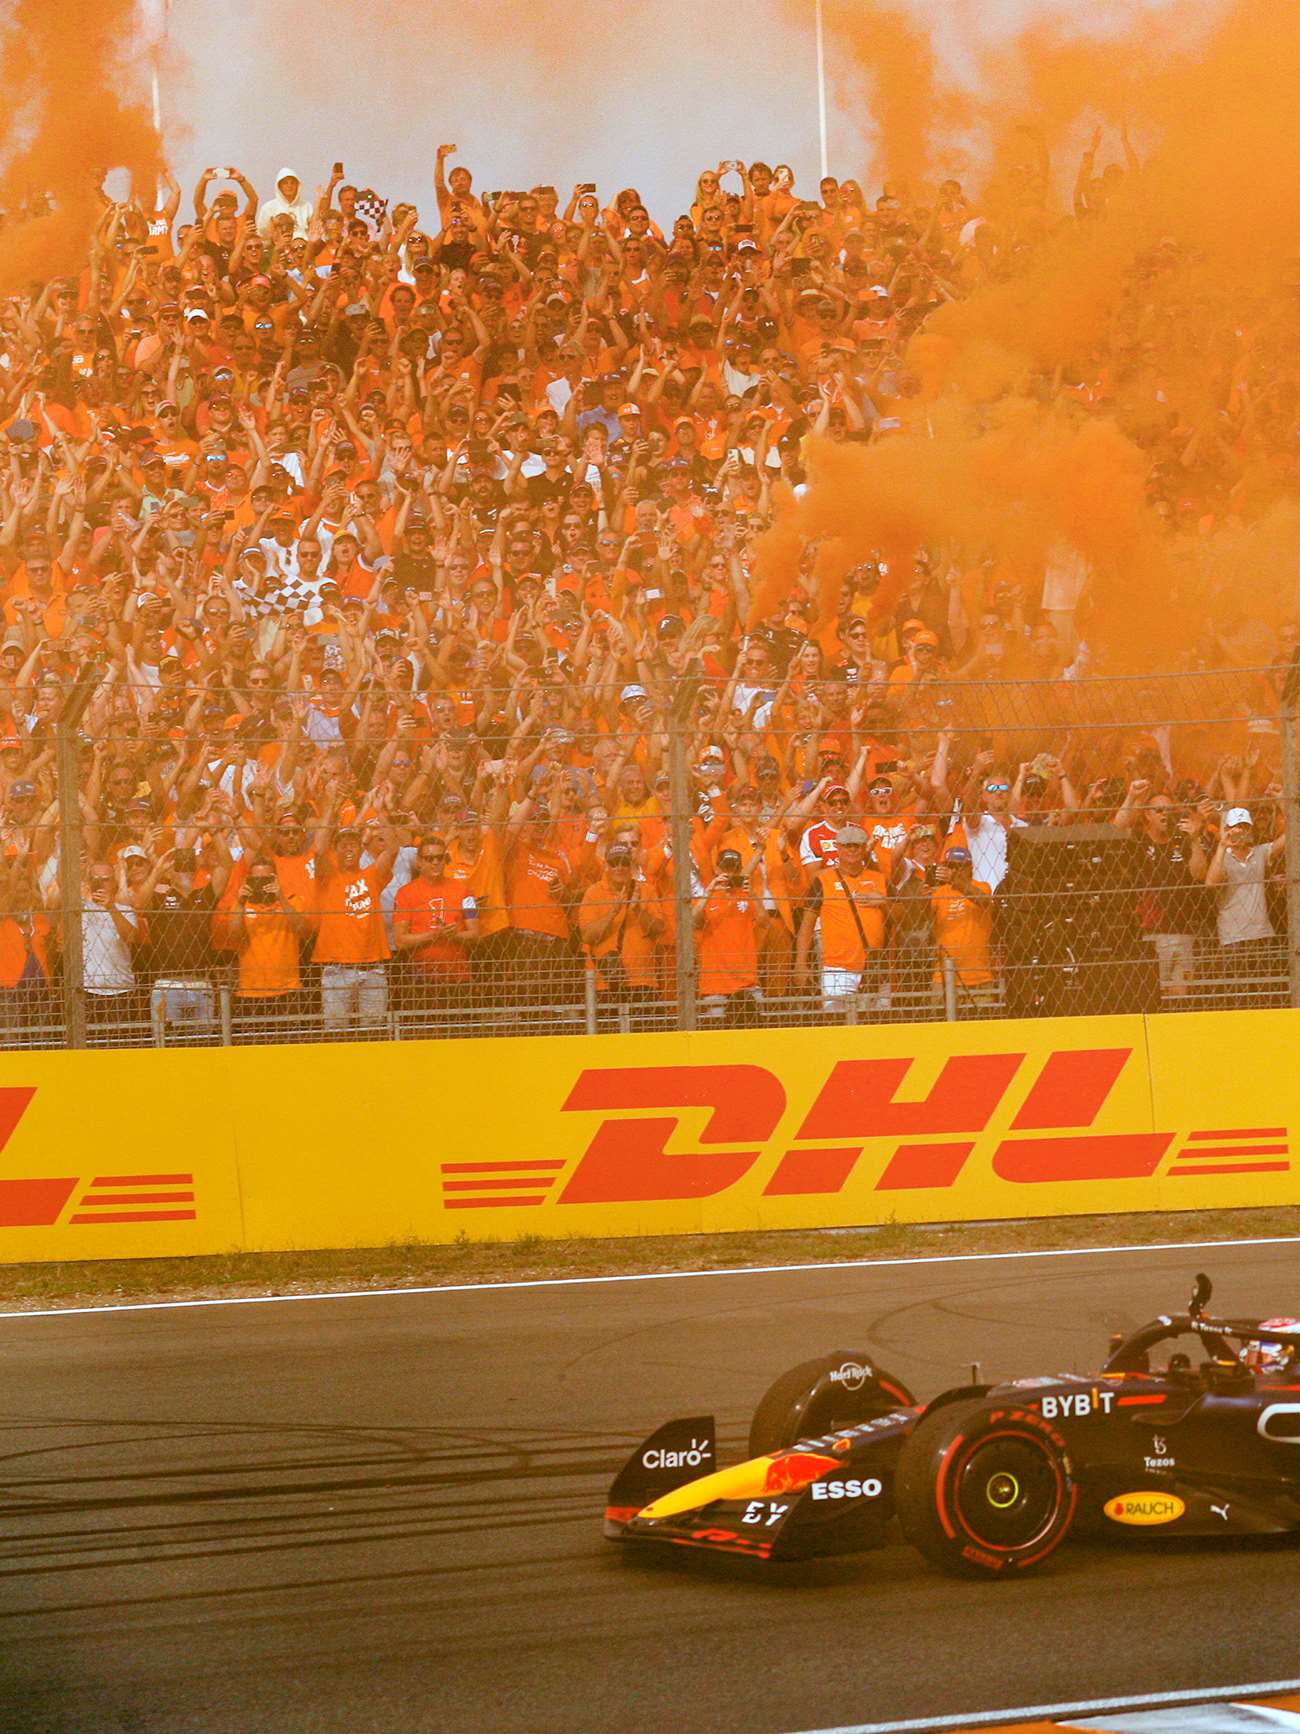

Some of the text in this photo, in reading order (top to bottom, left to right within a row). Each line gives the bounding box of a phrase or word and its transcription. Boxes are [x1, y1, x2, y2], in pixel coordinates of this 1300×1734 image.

[555, 1047, 1178, 1205] DHL
[1041, 1387, 1115, 1418] BYBIT
[642, 1444, 706, 1469] Claro
[1143, 1456, 1176, 1468] Tezos
[811, 1478, 883, 1500] ESSO
[741, 1501, 788, 1526] EY
[1126, 1502, 1174, 1516] RAUCH
